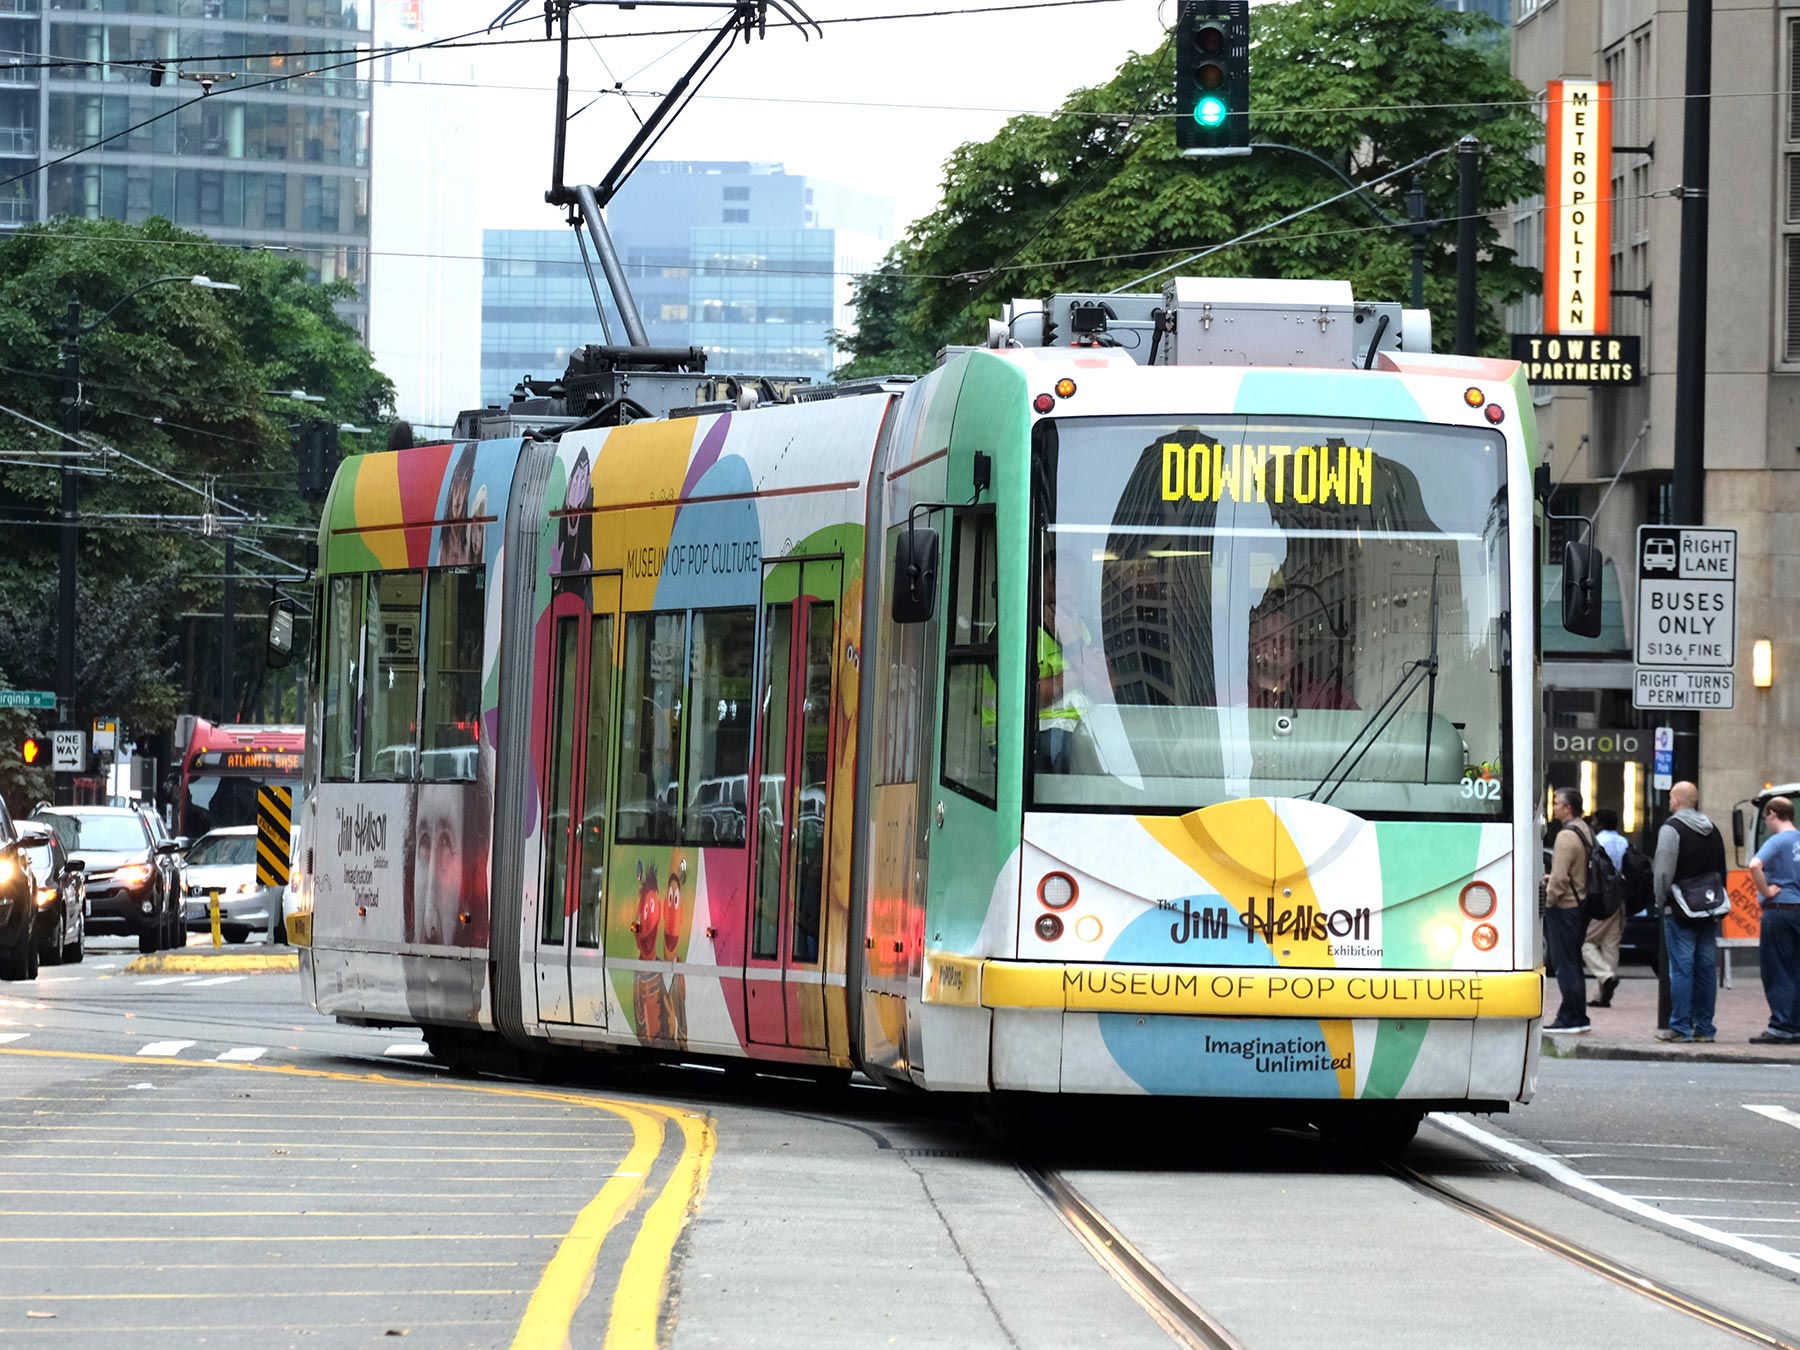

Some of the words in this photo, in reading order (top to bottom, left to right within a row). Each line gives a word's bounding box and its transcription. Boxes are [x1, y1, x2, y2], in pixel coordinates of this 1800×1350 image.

[1571, 92, 1588, 323] METROPOLITAN
[1530, 340, 1621, 360] TOWER
[1162, 442, 1372, 505] DOWNTOWN
[1683, 539, 1732, 554] RIGHT
[626, 547, 669, 578] MUSEUM
[671, 545, 686, 576] OF
[688, 543, 710, 575] POP
[711, 540, 759, 574] CULTURE
[1685, 558, 1729, 572] LANE
[1652, 592, 1725, 611] BUSES
[1659, 616, 1716, 635] ONLY
[1688, 644, 1722, 657] FINE
[1640, 674, 1678, 687] RIGHT
[1687, 675, 1730, 689] TURNS
[0, 692, 30, 706] irginia
[1649, 690, 1722, 704] PERMITTED
[56, 735, 79, 744] ONE
[1553, 732, 1639, 752] barolo
[56, 746, 79, 755] WAY
[228, 754, 272, 767] ATLANTIC
[275, 754, 299, 768] BASE
[1460, 777, 1501, 800] 302
[344, 864, 372, 890] Imagination
[355, 887, 379, 907] Unlimited
[1157, 899, 1178, 911] The
[1327, 944, 1384, 957] Exhibition
[1062, 970, 1197, 997] MUSEUM
[1211, 975, 1255, 998] OF
[1268, 976, 1335, 999] POP
[1347, 977, 1484, 1000] CULTURE
[1204, 1035, 1326, 1060] Imagination
[1255, 1053, 1352, 1073] Unlimited
